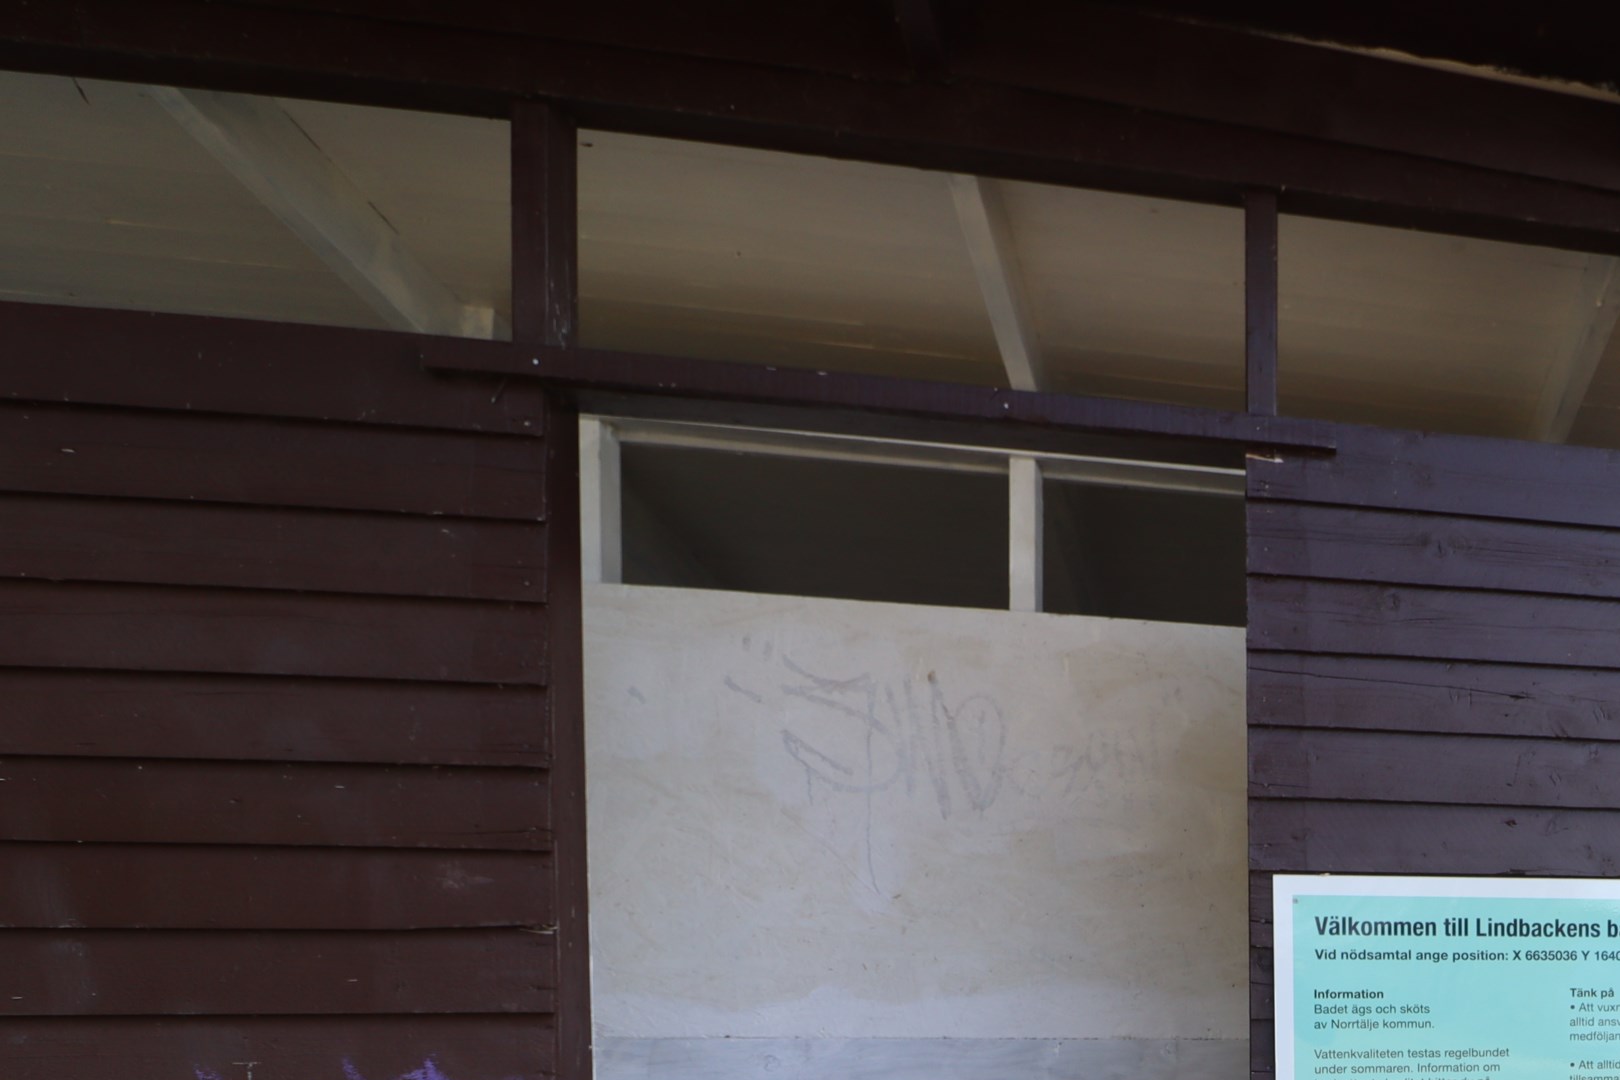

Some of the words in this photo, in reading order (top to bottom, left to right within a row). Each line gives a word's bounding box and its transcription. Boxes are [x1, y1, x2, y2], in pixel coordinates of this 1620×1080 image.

[1315, 916, 1437, 937] Välkommen
[1444, 917, 1469, 937] till
[1476, 917, 1600, 938] Lindbackens
[1315, 949, 1336, 960] Vid
[1340, 949, 1412, 961] nödsamtal
[1416, 951, 1449, 963] ange
[1453, 950, 1509, 963] position:
[1513, 951, 1521, 961] X
[1525, 950, 1578, 961] 6635036
[1582, 951, 1590, 961] Y
[1314, 989, 1383, 999] Information
[1570, 988, 1597, 998] Tänk
[1600, 988, 1614, 999] på
[1314, 1004, 1349, 1014] Badet
[1353, 1004, 1372, 1017] ägs
[1376, 1004, 1396, 1014] och
[1400, 1004, 1429, 1014] sköts
[1579, 1003, 1593, 1012] Att
[1314, 1020, 1327, 1029] av
[1331, 1019, 1378, 1030] Norrtälje
[1383, 1019, 1434, 1029] kommun.
[1570, 1017, 1595, 1026] alltid
[1315, 1048, 1403, 1059] Vattenkvaliteten
[1407, 1048, 1441, 1058] testas
[1444, 1047, 1509, 1059] regelbundet
[1315, 1064, 1347, 1074] under
[1351, 1064, 1413, 1073] sommaren.
[1418, 1063, 1479, 1072] Information
[1483, 1064, 1500, 1072] om
[1579, 1059, 1593, 1069] Att
[1596, 1059, 1620, 1069] alltid
